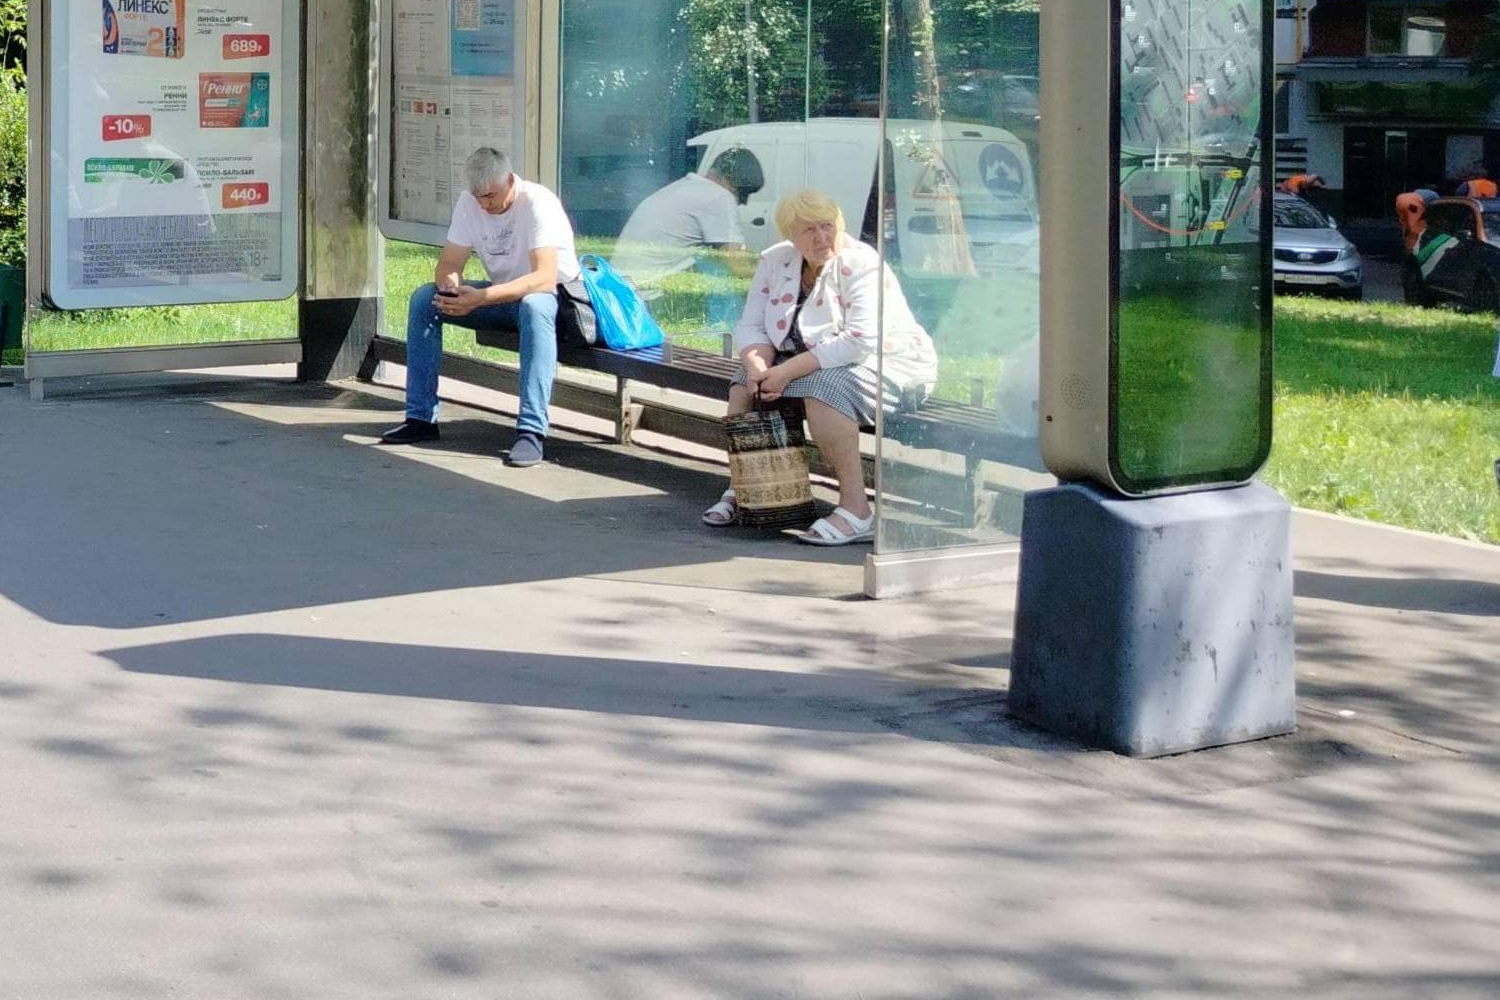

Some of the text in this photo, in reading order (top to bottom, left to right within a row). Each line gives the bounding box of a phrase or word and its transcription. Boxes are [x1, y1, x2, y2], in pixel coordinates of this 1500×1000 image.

[148, 27, 164, 57] 2
[108, 118, 145, 135] -10%
[249, 251, 269, 268] 18+
